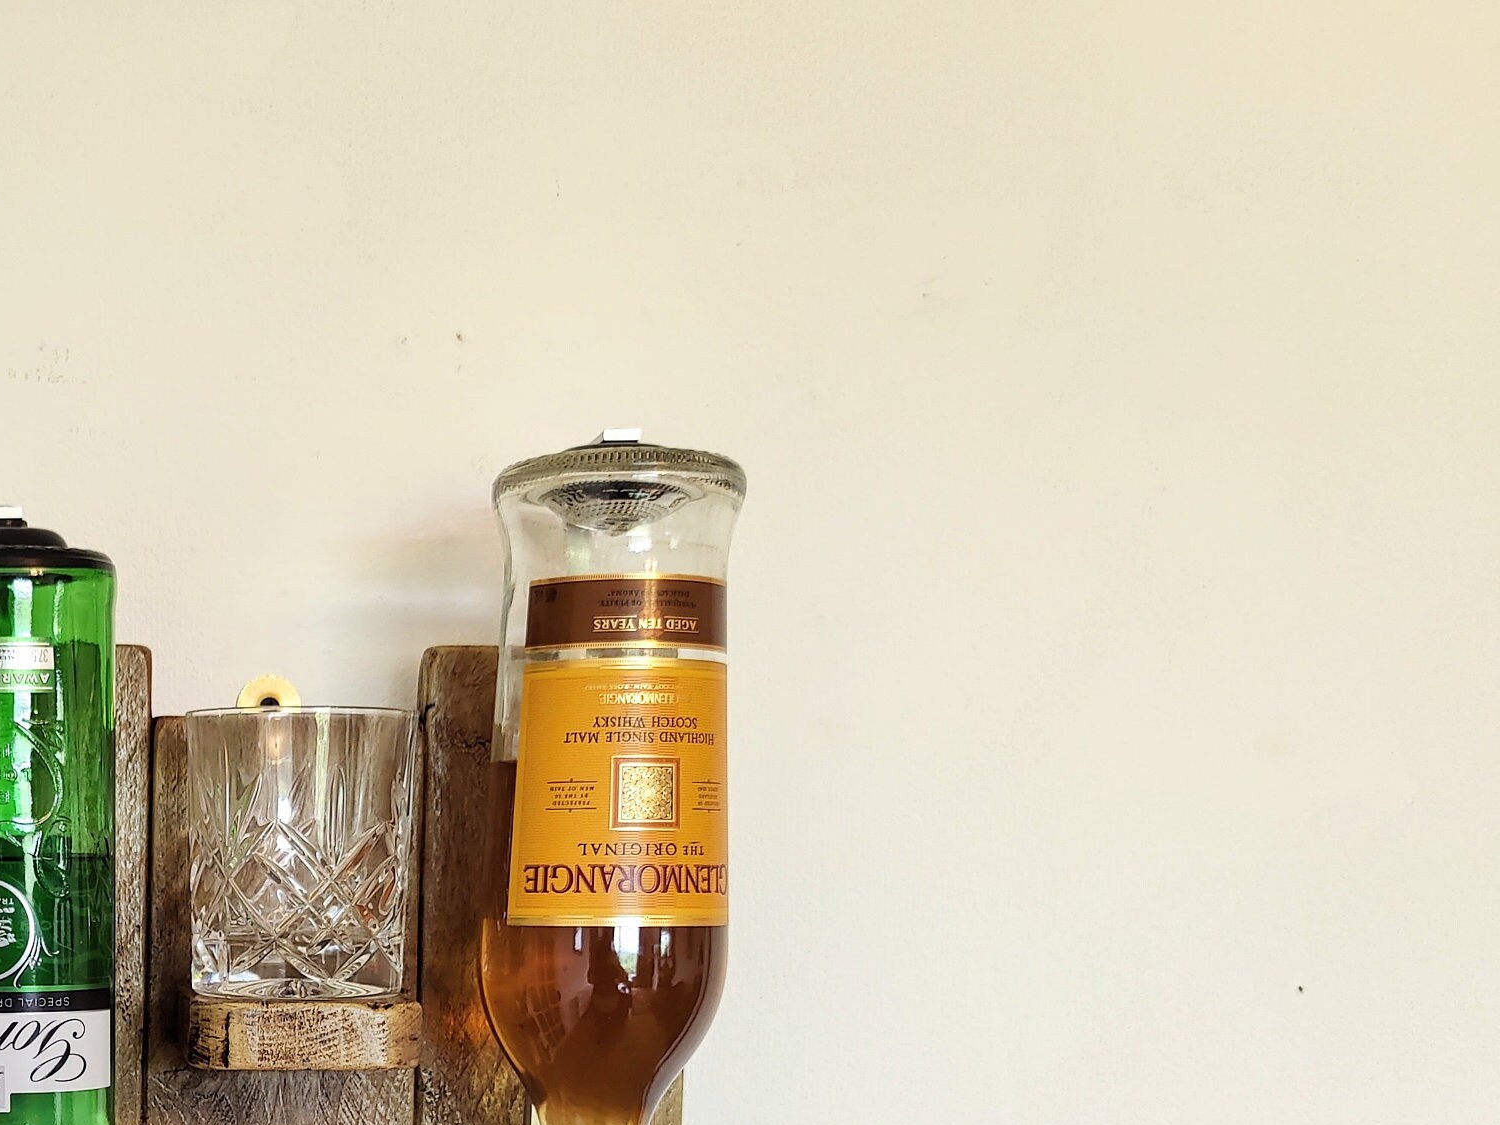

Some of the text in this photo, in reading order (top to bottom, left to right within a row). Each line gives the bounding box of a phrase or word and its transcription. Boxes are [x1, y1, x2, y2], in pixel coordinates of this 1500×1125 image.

[593, 618, 696, 630] AGED TEN YEARS
[592, 716, 697, 729] SCOTCH WHISKY
[563, 731, 714, 746] HIGHLAND SINGLE MALT
[577, 842, 704, 856] THE ORIGINAL
[523, 864, 728, 895] GLENMORANGIE
[18, 996, 70, 1007] SPECIAL
